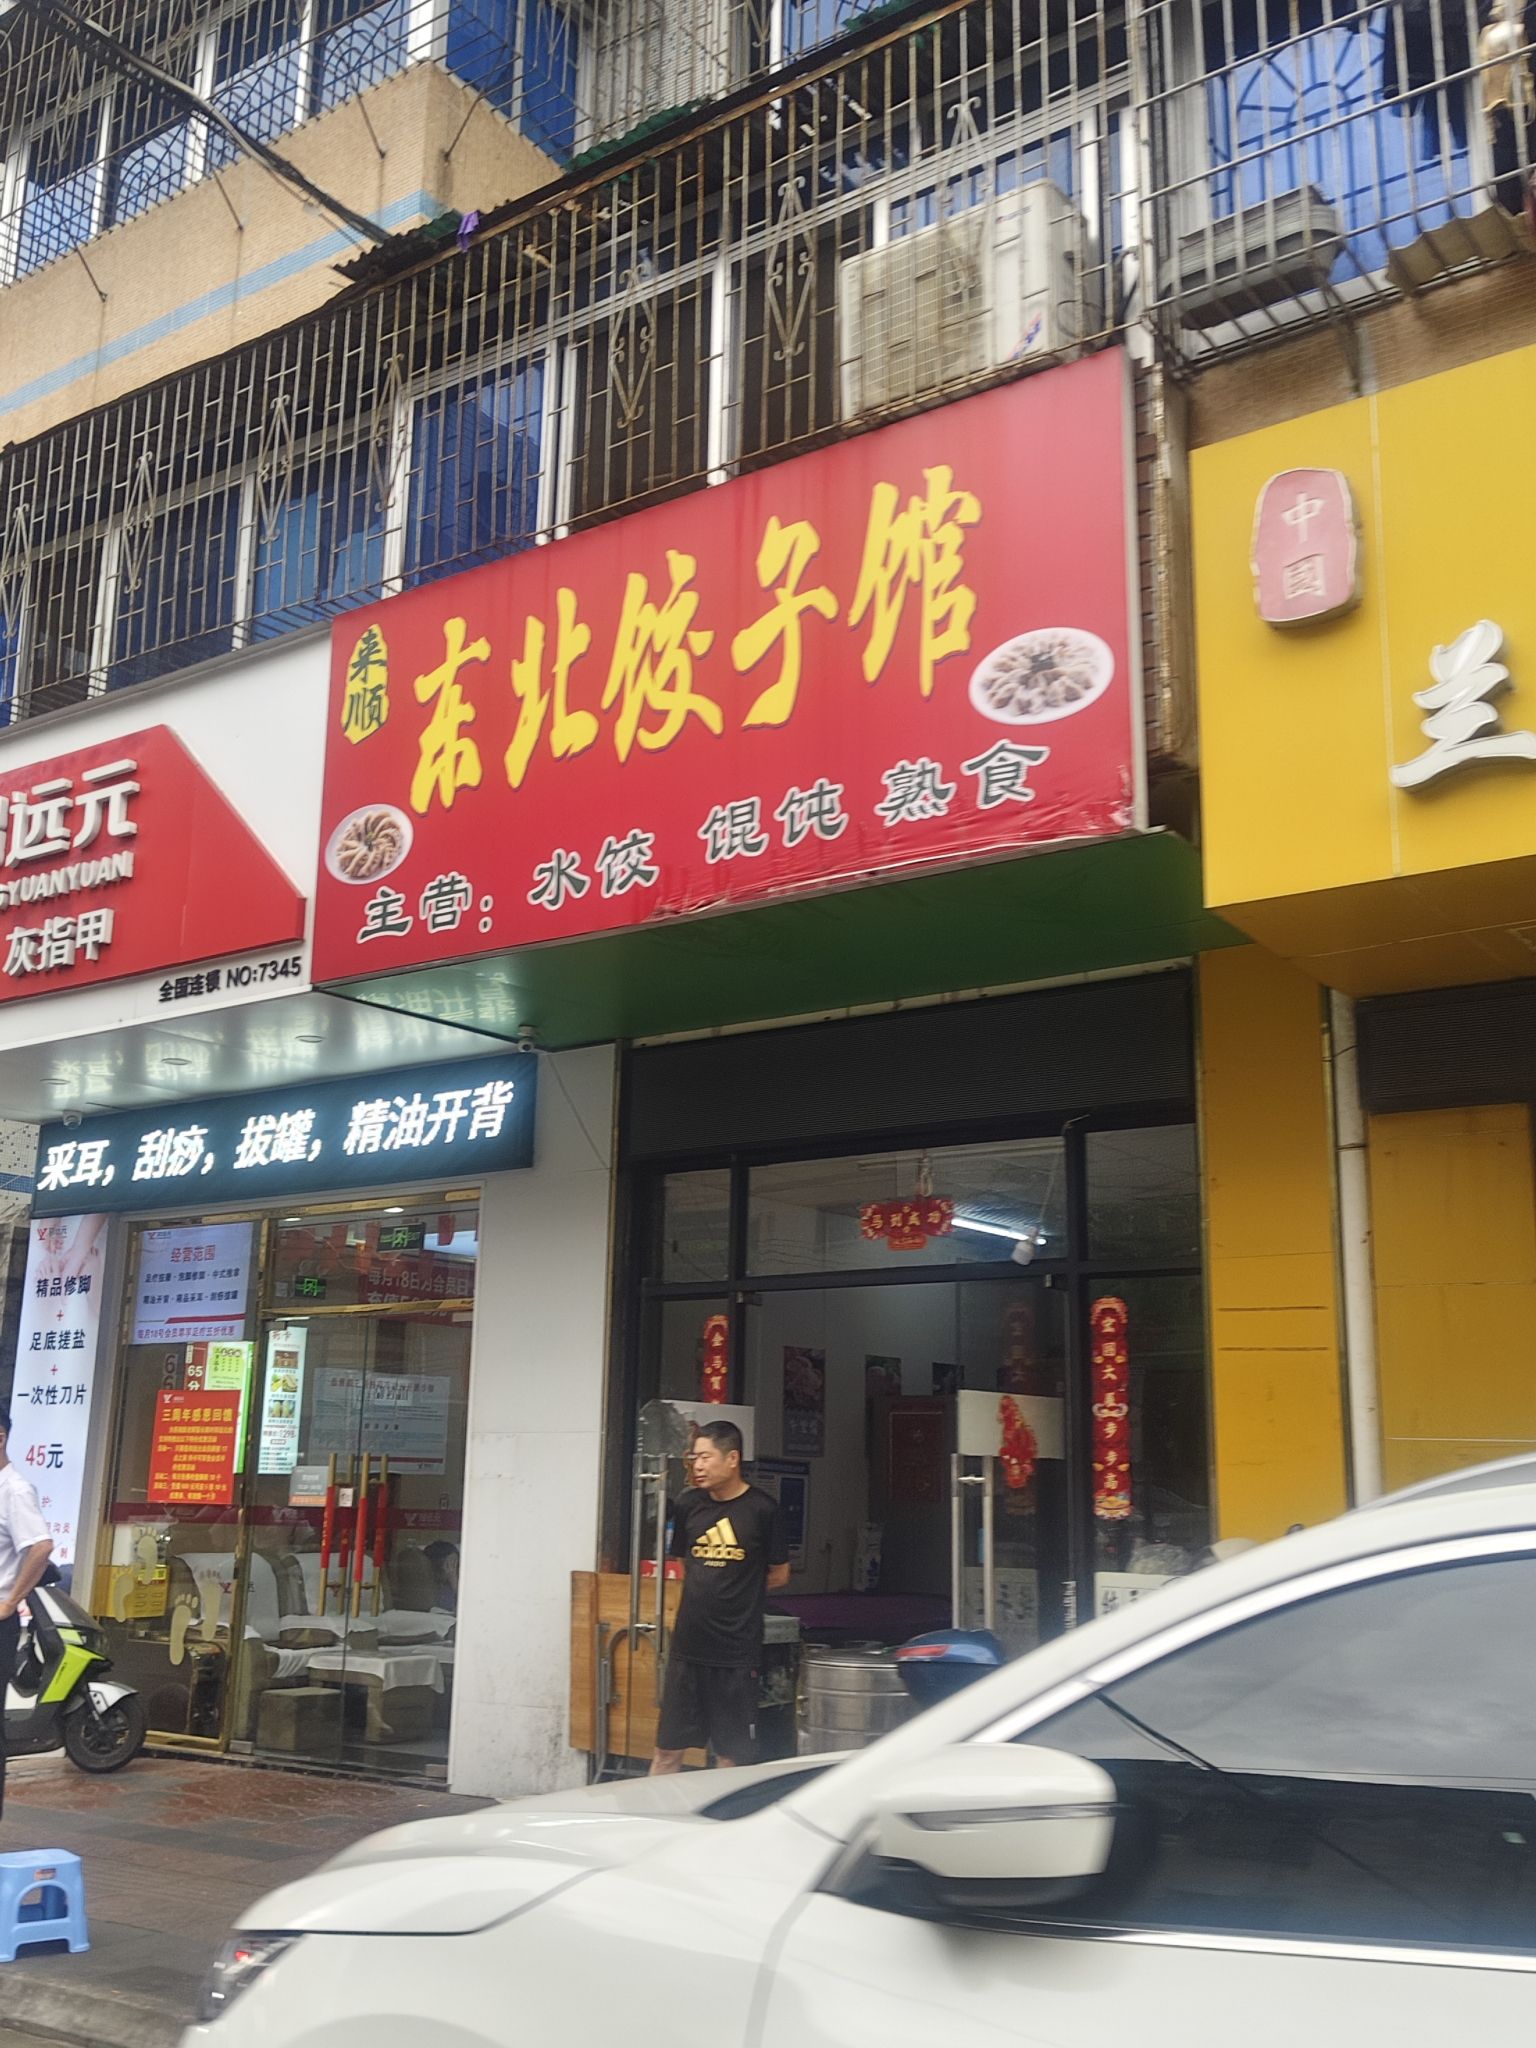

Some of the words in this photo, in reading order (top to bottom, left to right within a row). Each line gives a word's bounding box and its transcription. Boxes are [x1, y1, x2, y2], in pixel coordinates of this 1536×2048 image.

[410, 464, 983, 815] 东北饺子馆
[528, 832, 660, 912] 水饺
[698, 778, 849, 863] 馄饨
[875, 739, 1052, 827] 熟食
[2, 908, 115, 977] 灰指甲
[170, 1244, 216, 1263] 经营范围
[36, 1275, 92, 1298] 精品修脚
[29, 1328, 86, 1351] 足底搓盐
[17, 1383, 87, 1406] 一次性刀片
[25, 1443, 64, 1469] 45元
[691, 1545, 746, 1561] adidas
